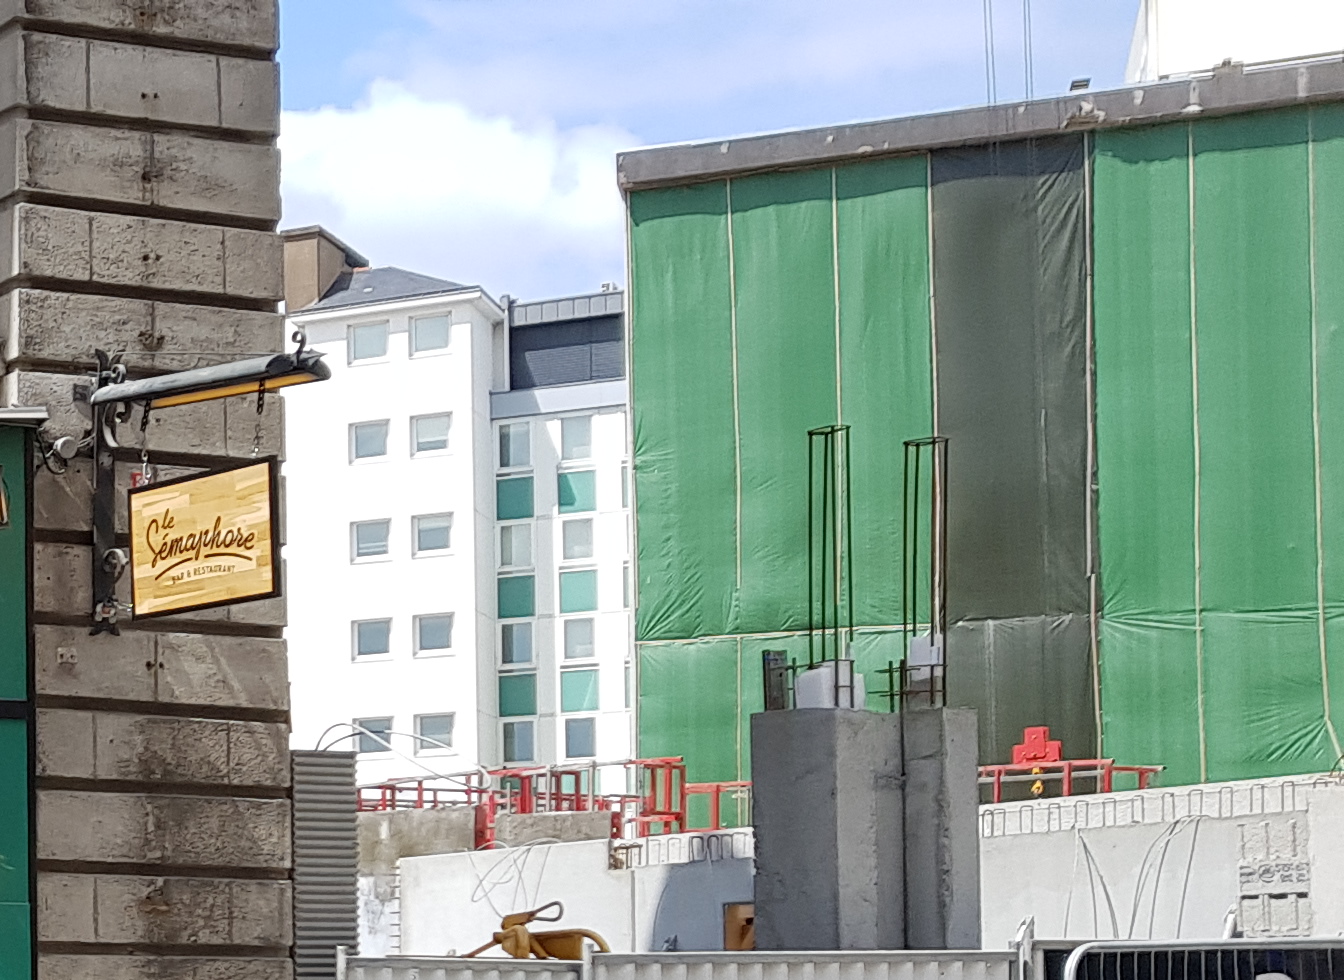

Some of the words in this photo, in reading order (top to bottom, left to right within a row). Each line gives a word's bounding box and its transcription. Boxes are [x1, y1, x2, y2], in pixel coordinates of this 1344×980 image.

[161, 508, 175, 530] le
[146, 516, 255, 568] Sémaphore
[171, 572, 184, 585] BAR
[193, 565, 236, 577] RESTAURANT
